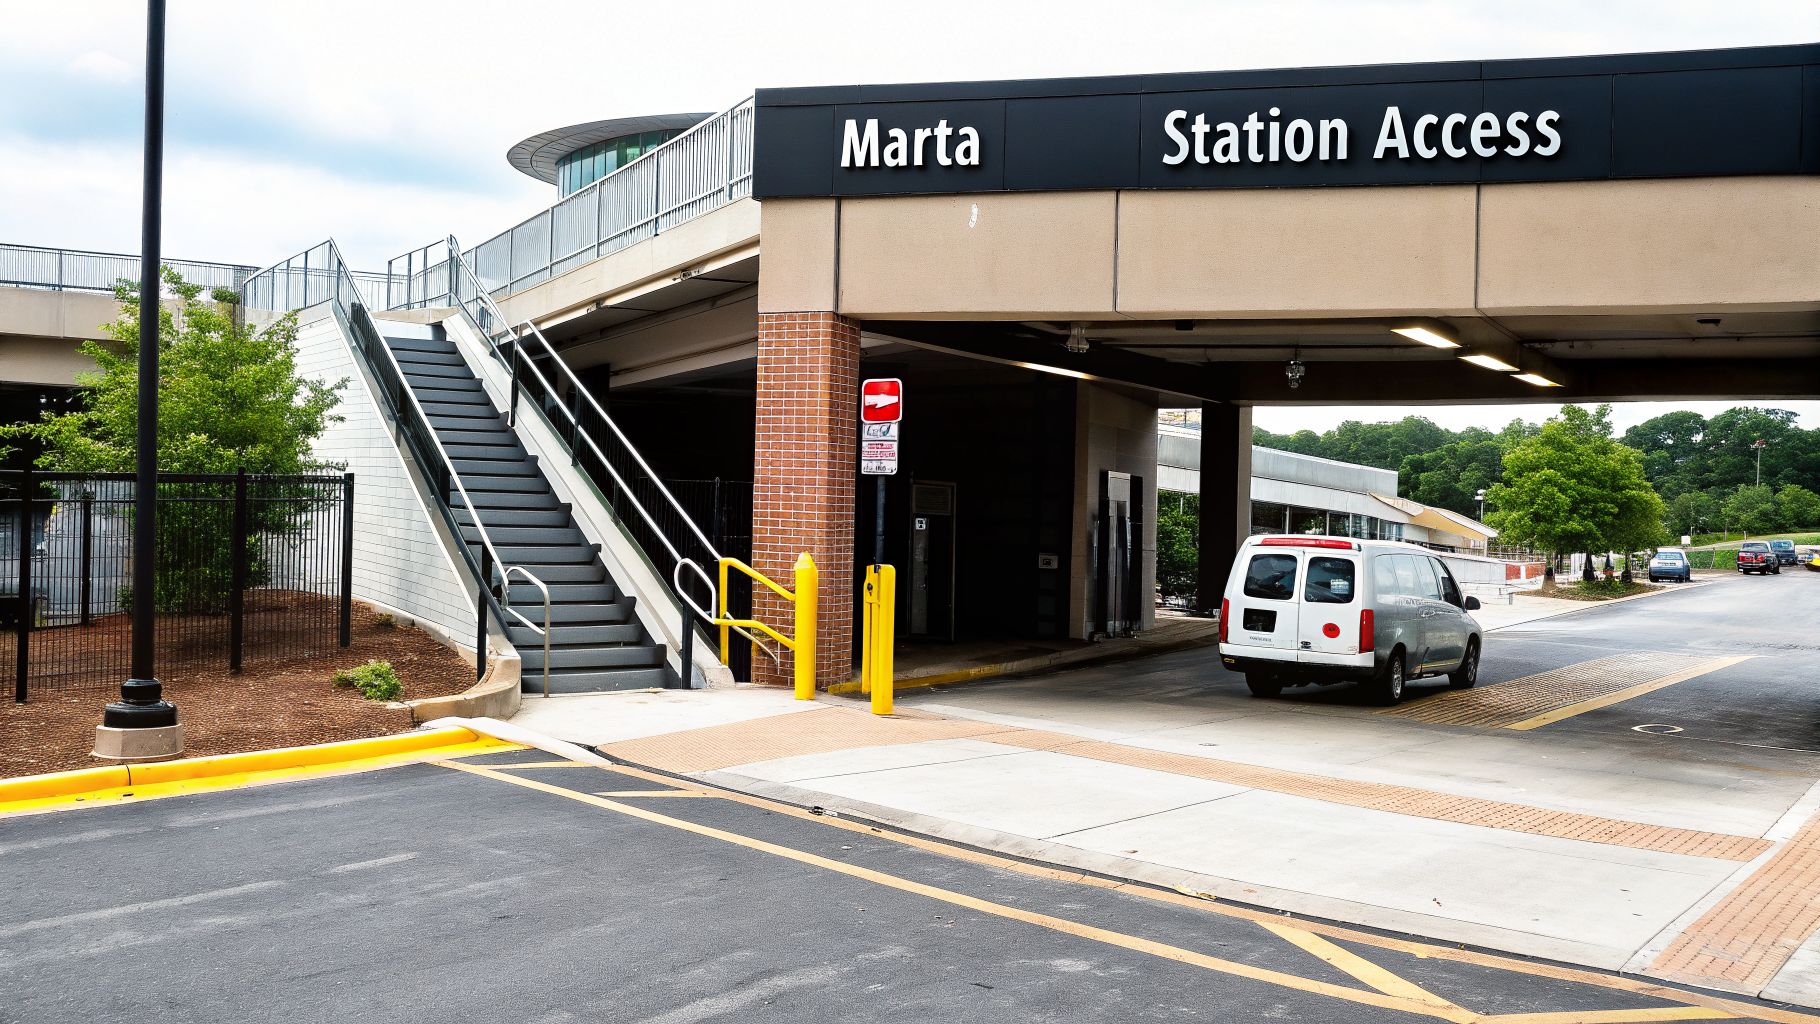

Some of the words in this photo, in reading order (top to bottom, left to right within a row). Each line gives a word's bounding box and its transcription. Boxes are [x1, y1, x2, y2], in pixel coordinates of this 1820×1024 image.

[841, 119, 980, 168] Marta
[1163, 107, 1348, 165] Station
[1373, 107, 1561, 159] Access
